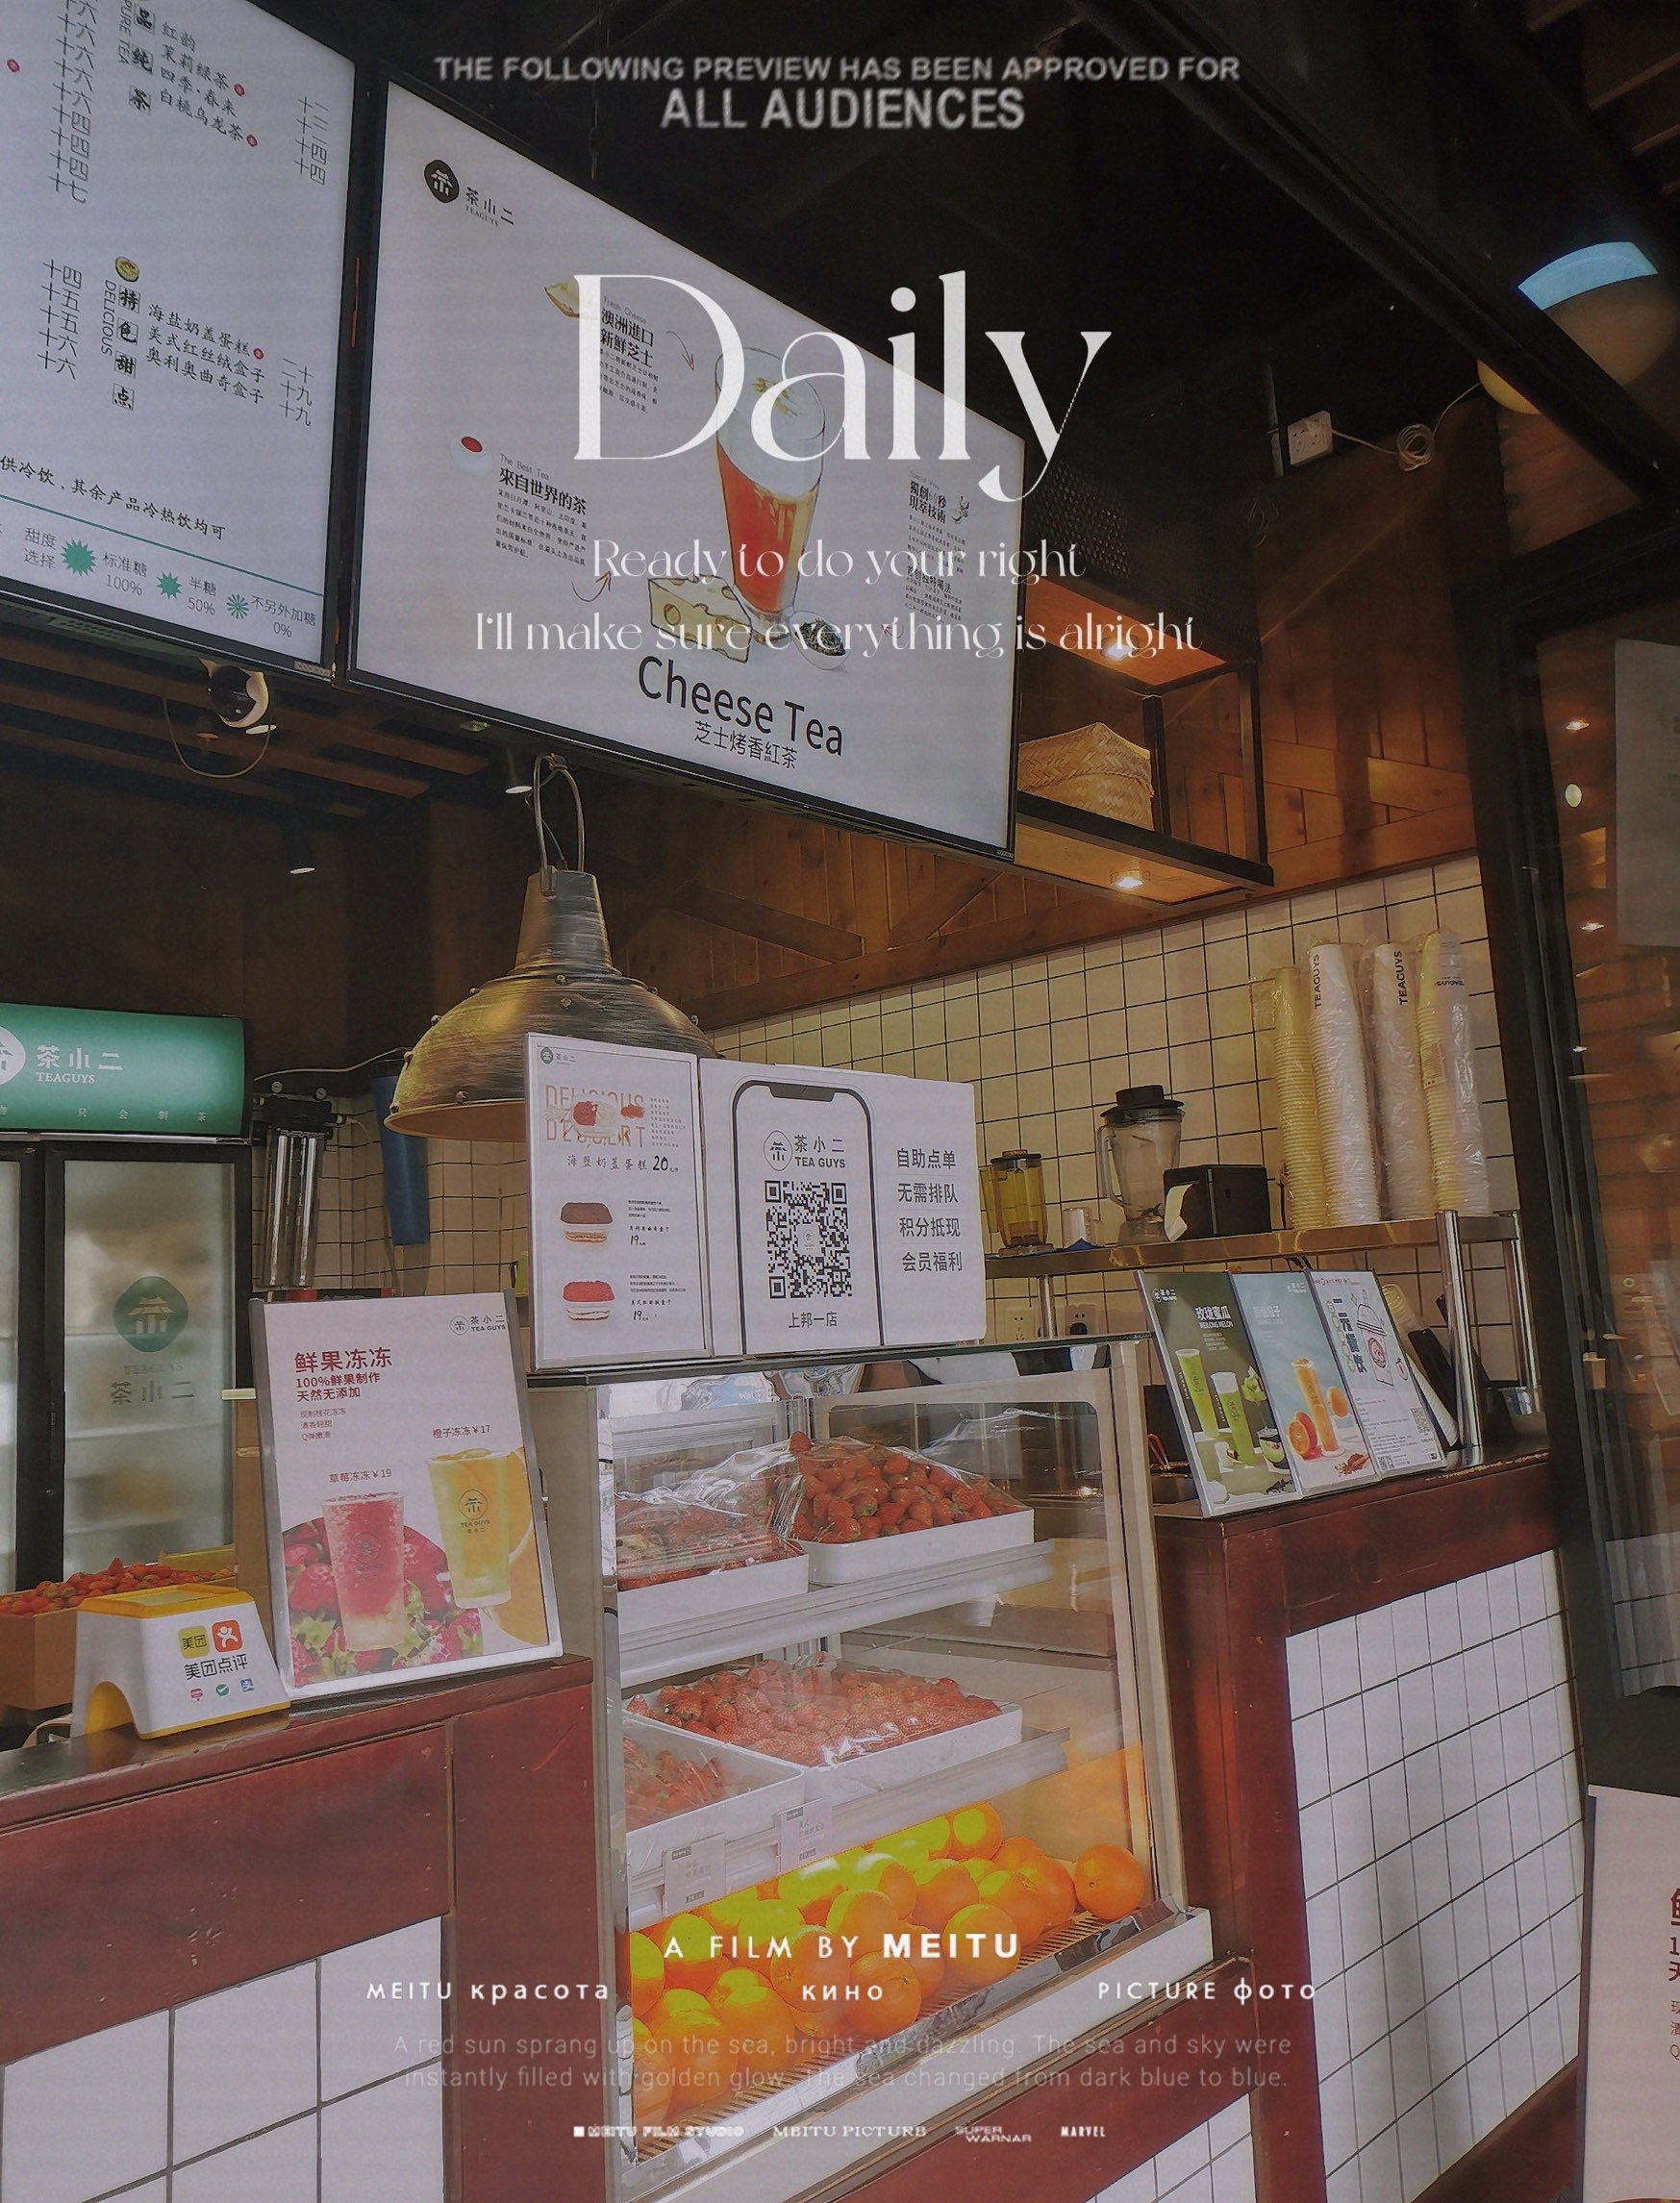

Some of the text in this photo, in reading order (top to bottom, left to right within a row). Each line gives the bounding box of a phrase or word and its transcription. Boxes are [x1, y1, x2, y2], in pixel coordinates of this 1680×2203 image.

[117, 38, 130, 64] TEA
[465, 187, 514, 225] 茶小二
[100, 279, 116, 356] DELICIOUS
[601, 307, 655, 347] 澳洲進口
[148, 303, 250, 357] 海盐奶盖蛋糕
[147, 325, 265, 385] 美式红丝绒盒子
[599, 328, 654, 368] 新鮮芝士
[146, 346, 264, 405] 奥利奥曲奇盒子
[499, 467, 587, 515] 來自世界的茶
[25, 528, 58, 551] 甜度
[23, 548, 57, 570] 选择
[102, 552, 148, 578] 标准糖
[105, 574, 144, 596] 100%
[188, 577, 217, 597] 半糖
[187, 596, 216, 616] 50%
[250, 595, 317, 628] 不另外加糖
[273, 622, 293, 638] 0%
[639, 655, 842, 757] Cheese Tea
[694, 719, 798, 769] 芝士烤香紅茶
[1312, 953, 1321, 1011] TEAGUYS
[1393, 950, 1410, 1006] TEAGUYS
[37, 1044, 124, 1071] 茶小二
[36, 1072, 96, 1085] TEAGUYS
[794, 1135, 846, 1153] 茶小二
[652, 1154, 669, 1171] 20
[794, 1157, 846, 1169] TEA GUYS
[897, 1147, 957, 1170] 自助点单
[897, 1182, 959, 1204] 无需排队
[899, 1216, 962, 1239] 积分抵现
[901, 1251, 964, 1273] 会员福利
[470, 1314, 505, 1325] 茶小二
[788, 1311, 839, 1329] 上邦一店
[294, 1347, 392, 1373] 鲜果冻冻
[110, 1380, 196, 1405] 茶小二
[295, 1372, 381, 1389] 100%鲜果制作
[297, 1387, 361, 1402] 天然无添加
[182, 1634, 207, 1649] 美团
[184, 1653, 248, 1680] 美团点评
